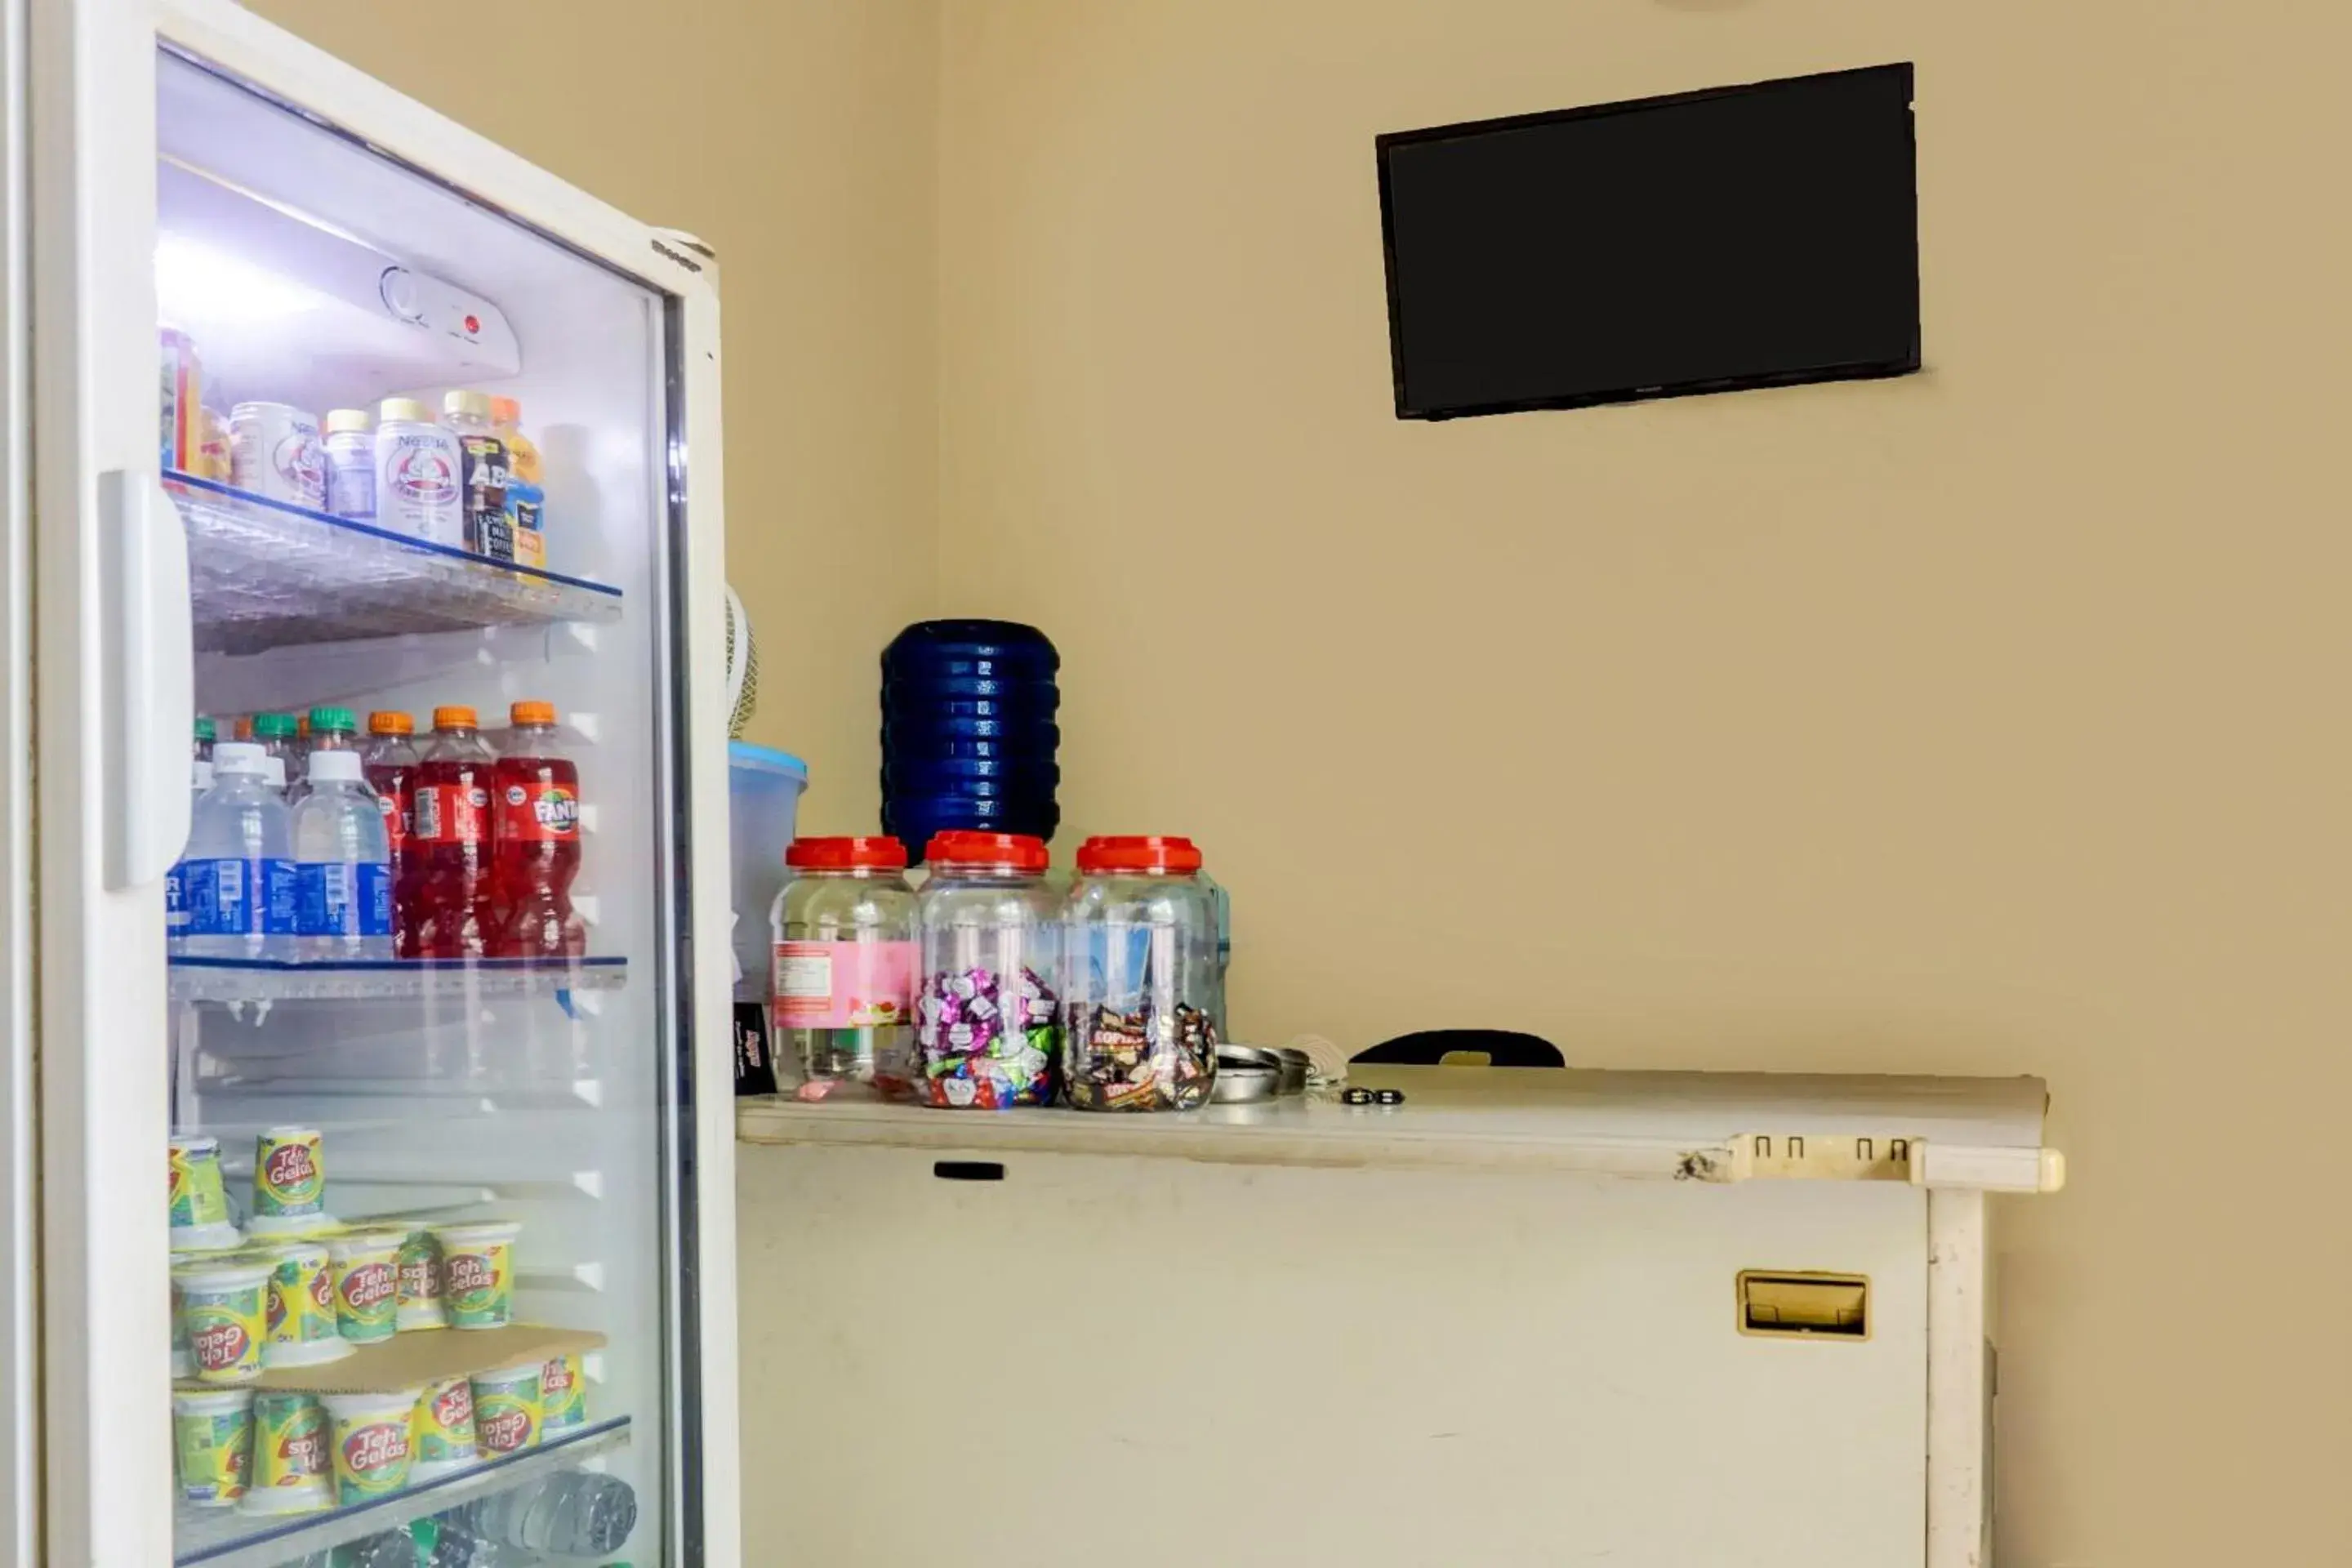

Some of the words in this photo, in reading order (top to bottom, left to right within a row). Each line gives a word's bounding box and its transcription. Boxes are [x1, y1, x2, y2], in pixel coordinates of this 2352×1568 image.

[278, 1144, 308, 1166] Teh
[270, 1162, 314, 1184] Gelas
[358, 1267, 388, 1289] Teh
[450, 1258, 480, 1276] Teh
[449, 1272, 493, 1293] Gelas
[202, 1344, 234, 1366] Teh
[359, 1428, 396, 1450] Teh
[490, 1428, 519, 1449] Teh
[350, 1441, 407, 1470] Gelas
